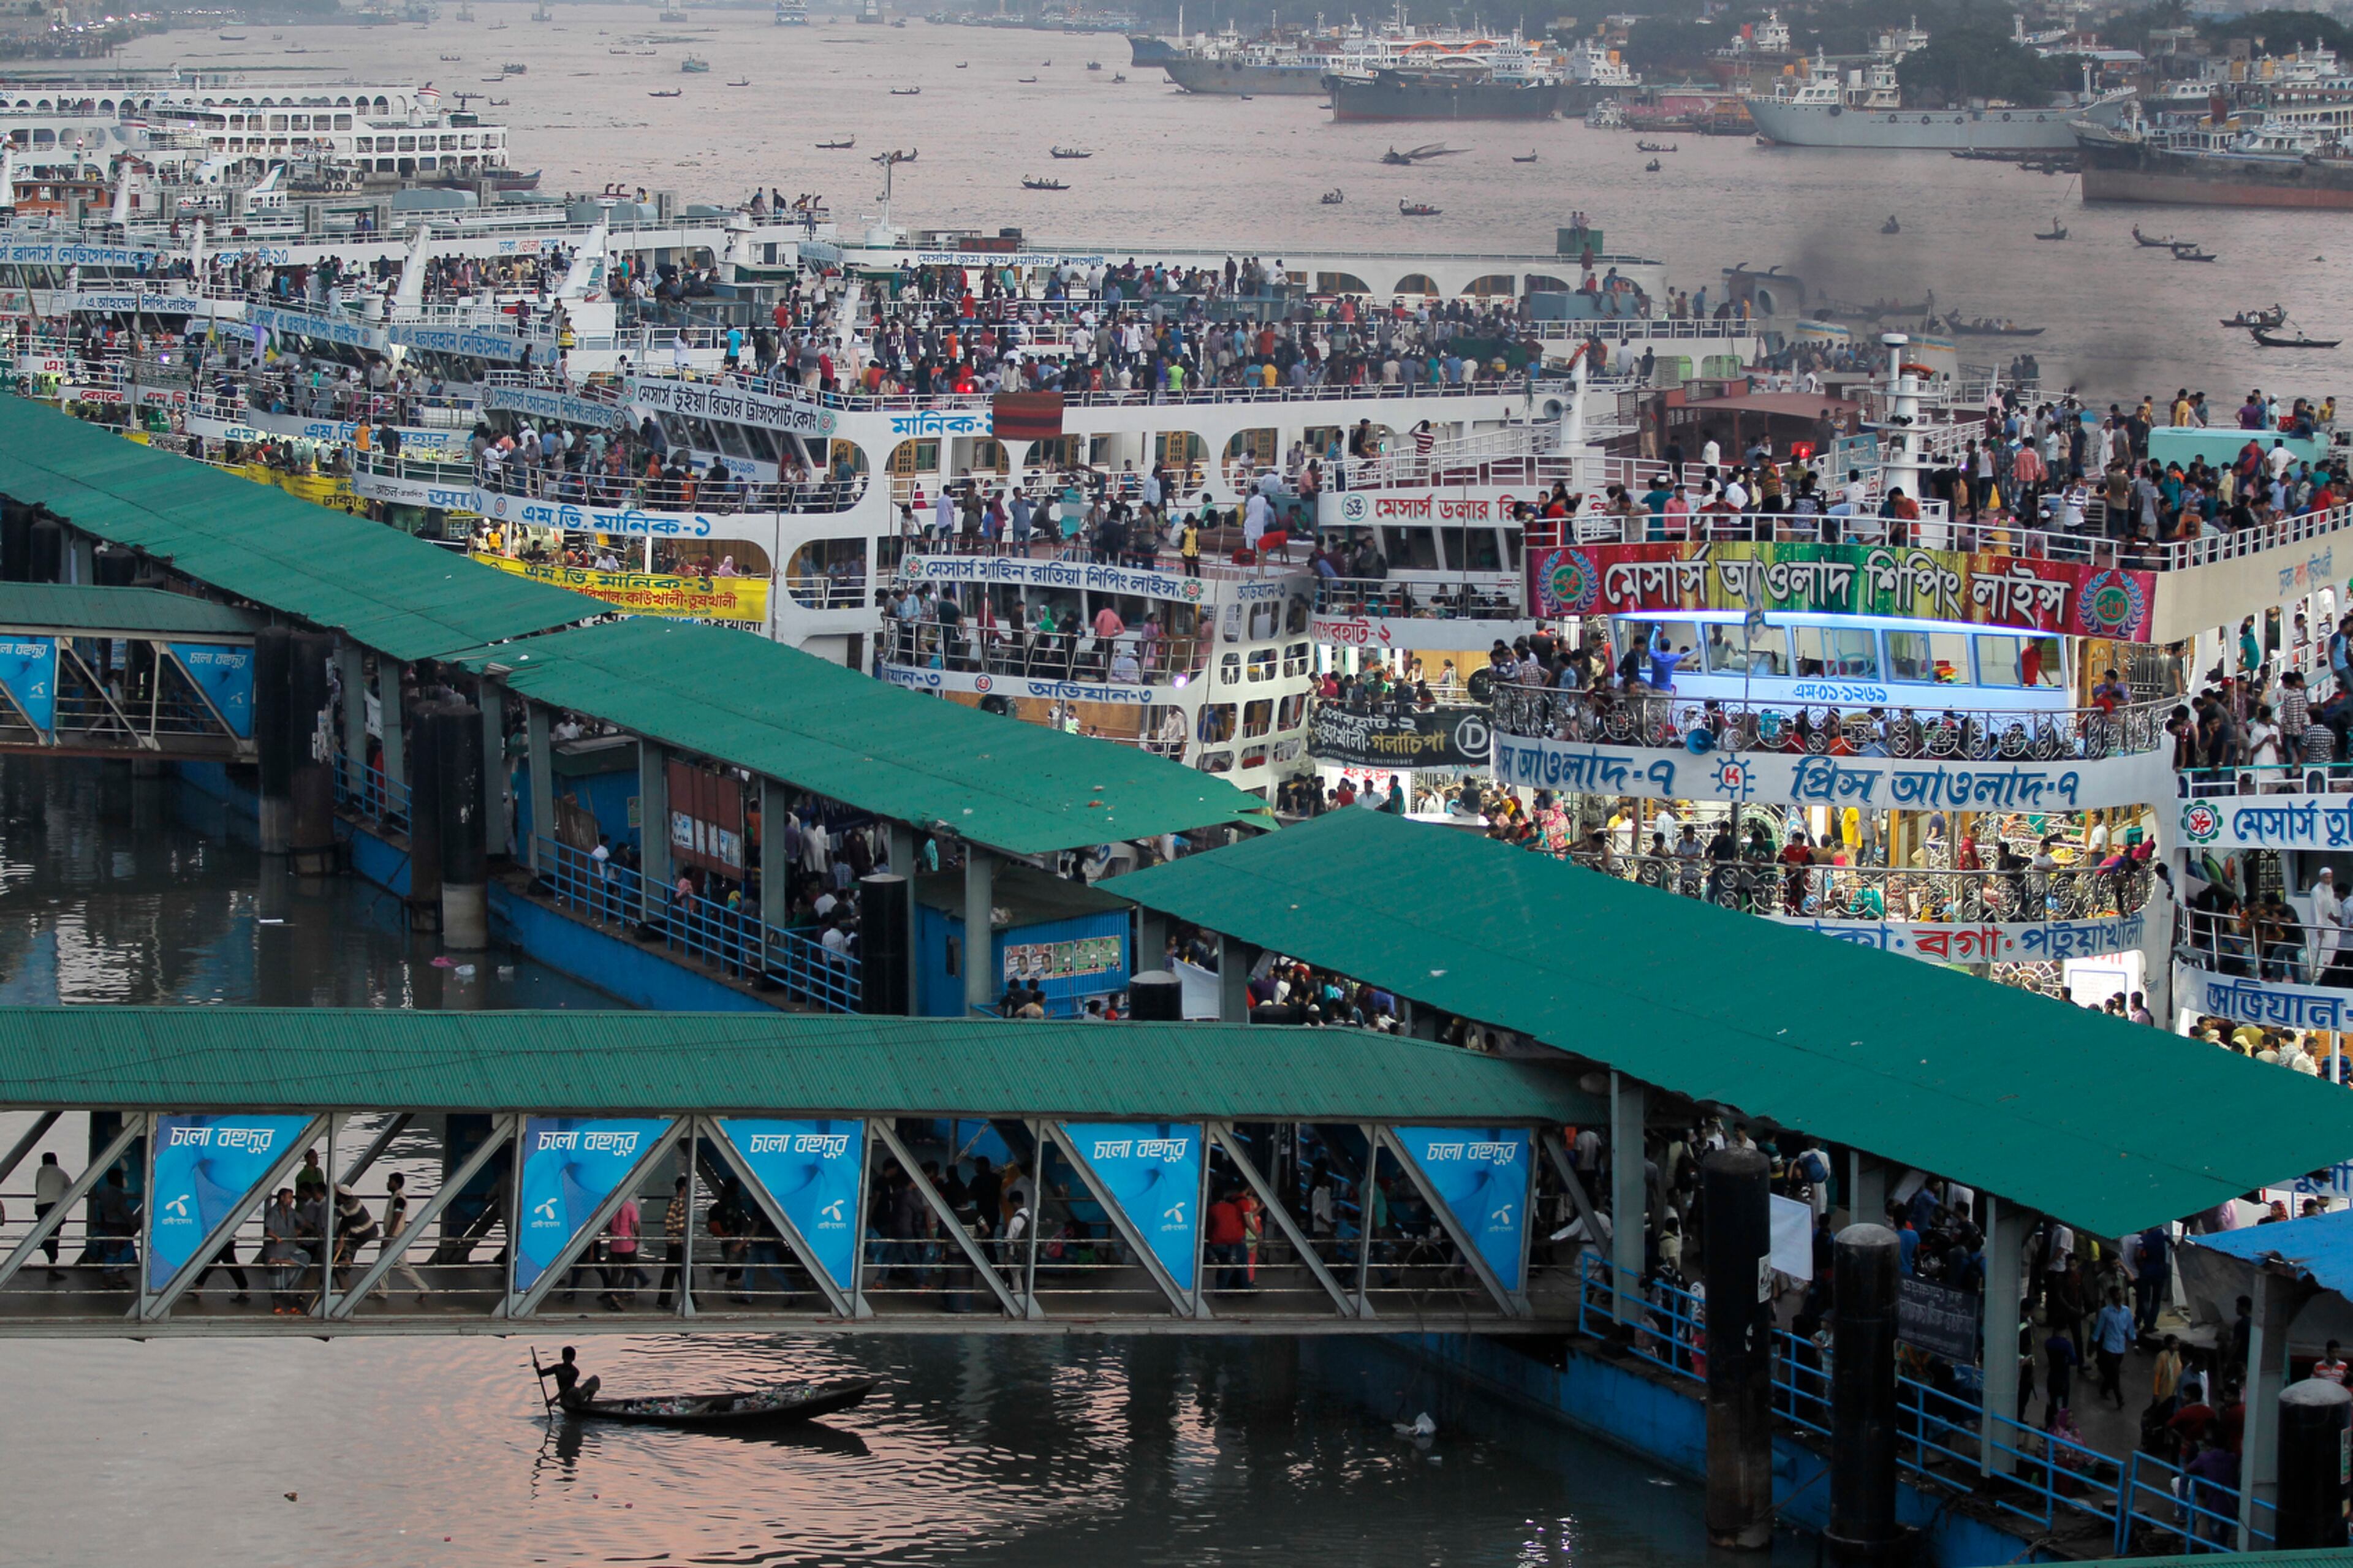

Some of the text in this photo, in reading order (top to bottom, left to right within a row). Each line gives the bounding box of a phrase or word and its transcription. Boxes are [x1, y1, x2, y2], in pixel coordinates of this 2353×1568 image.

[58, 244, 128, 264] নেভিগেশন
[415, 331, 457, 350] ফারহান
[460, 329, 512, 357] নেভিগেশন
[638, 382, 671, 405] মেসার্স
[708, 388, 744, 419] রিভার
[792, 409, 817, 430] কোং
[1375, 494, 1433, 520] মেসার্স
[1438, 500, 1490, 521] ডলার
[593, 510, 711, 536] মানিক-১
[926, 558, 976, 578] মেসার্স
[1085, 565, 1127, 590] শিপিং
[1604, 542, 2073, 627] মেসার্স আওলাদ শিপিং লাইন্স
[1237, 579, 1286, 600] অভিযান-৩
[1311, 617, 1392, 647] বাগেরহাট-২
[1028, 680, 1153, 704] অভিযান-৩
[1370, 729, 1447, 754] গলাচিপা
[1464, 722, 1488, 749] D
[1517, 741, 1676, 796] আওলাদ-৭
[1789, 755, 2080, 807] প্রিন্স আওলাদ-৭
[2233, 798, 2319, 843] মেসার্স
[1911, 926, 2004, 960] বগা
[2021, 912, 2145, 961] পটুয়াখালী
[170, 1127, 213, 1146] চলো
[538, 1131, 580, 1151] চলো
[750, 1134, 791, 1153] চলো
[1093, 1140, 1132, 1160] চলো
[1427, 1143, 1465, 1161] চলো
